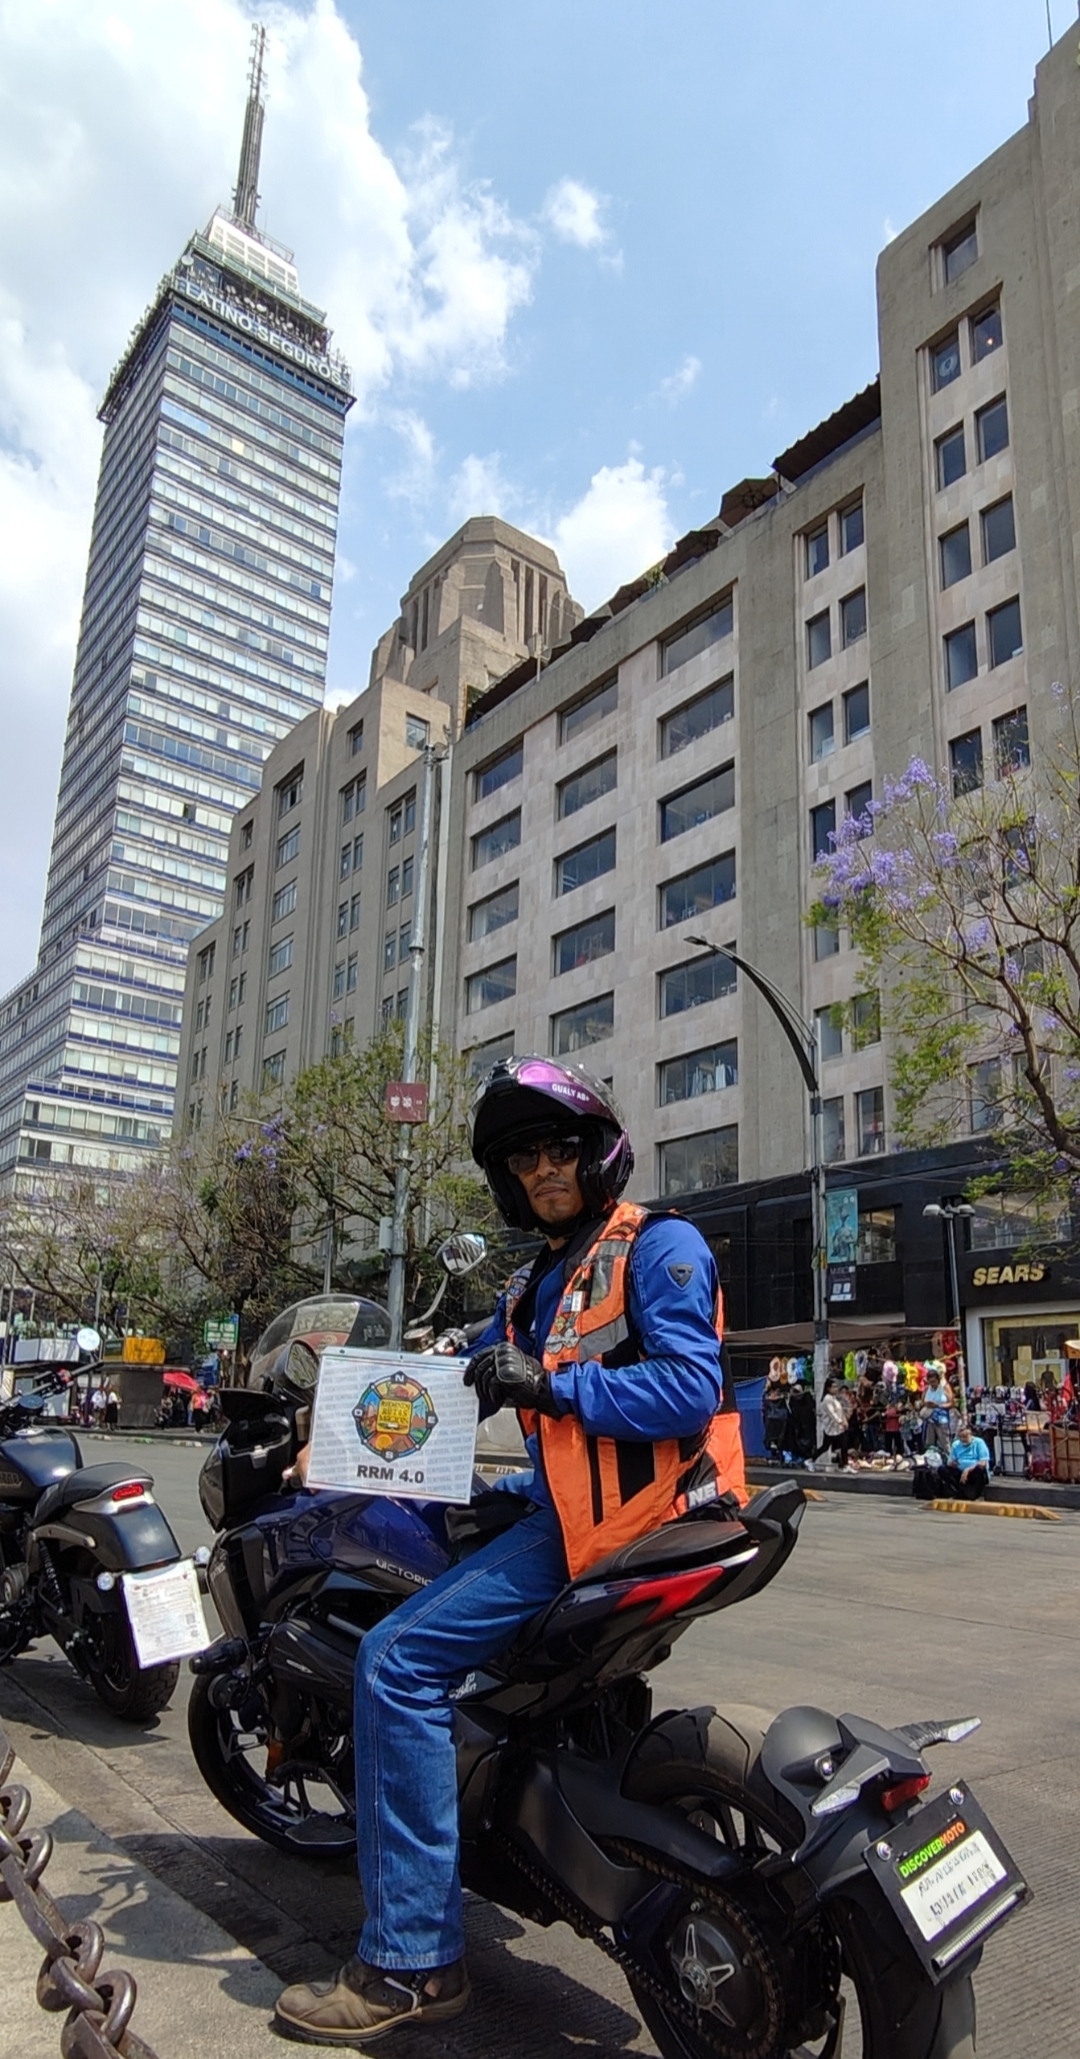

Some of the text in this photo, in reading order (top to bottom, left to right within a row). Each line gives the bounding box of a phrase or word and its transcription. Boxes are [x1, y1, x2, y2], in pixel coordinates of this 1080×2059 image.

[185, 278, 343, 386] LATINO SEGUROS
[552, 1083, 576, 1098] GUALY
[973, 1261, 1045, 1286] SEARS
[395, 1374, 405, 1383] N
[356, 1464, 394, 1481] RRM
[399, 1469, 425, 1484] 4.0
[899, 1821, 966, 1879] DISCOVERMOTO
